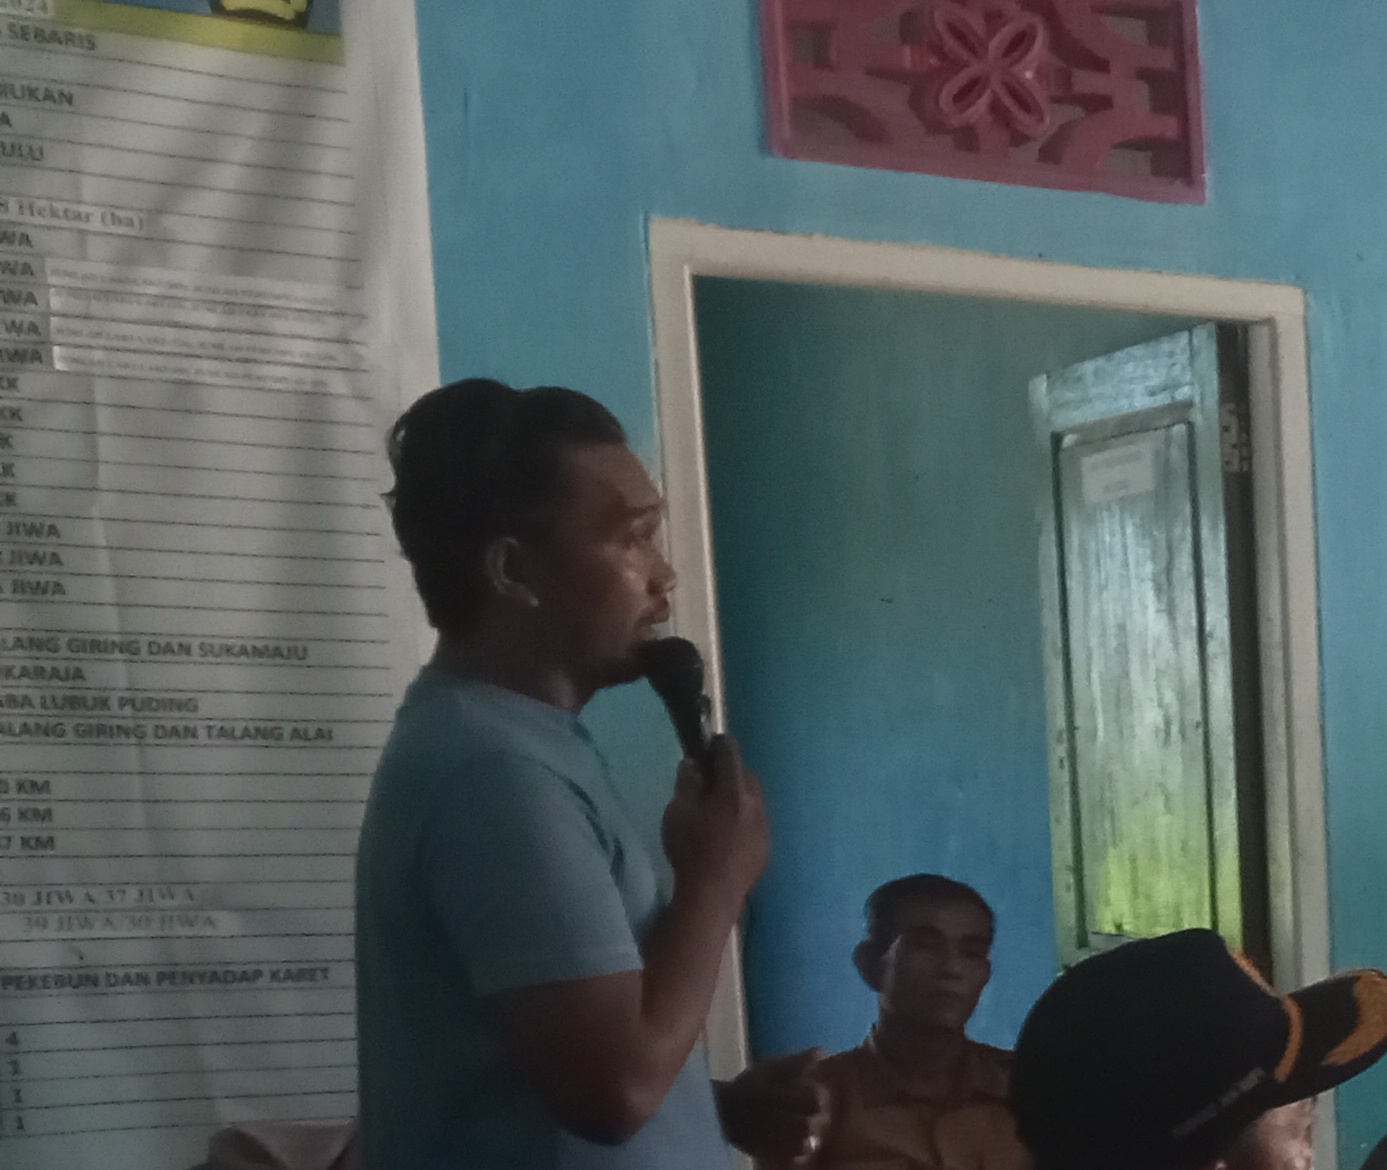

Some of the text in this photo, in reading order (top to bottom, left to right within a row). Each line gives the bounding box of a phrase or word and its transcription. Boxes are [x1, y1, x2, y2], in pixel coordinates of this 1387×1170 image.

[7, 22, 97, 51] SEBARIS
[66, 639, 141, 656] GIRING
[147, 641, 192, 657] DAN
[198, 642, 309, 660] SUKAMAJU
[40, 695, 111, 711] LUBUK
[117, 695, 199, 713] PUDING
[72, 723, 147, 740] GIRING
[153, 724, 199, 740] DAN
[205, 724, 284, 741] TALANG
[105, 971, 150, 987] DAN
